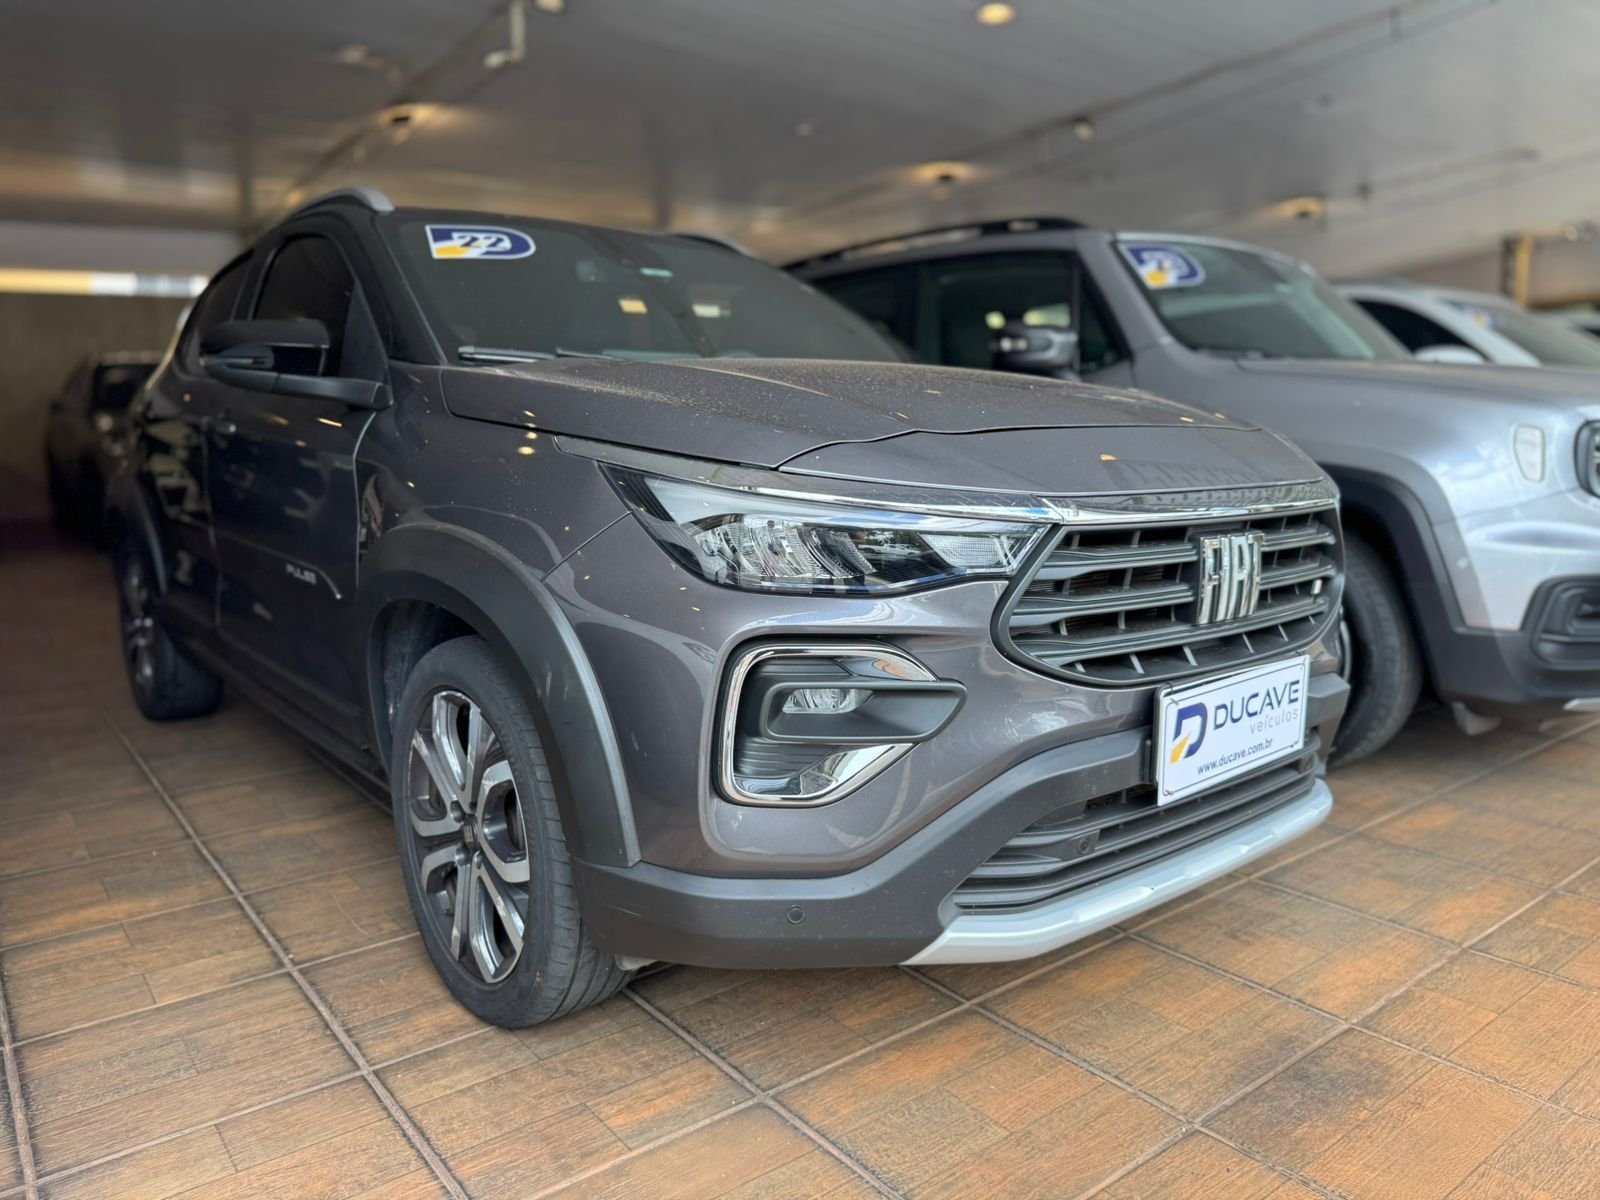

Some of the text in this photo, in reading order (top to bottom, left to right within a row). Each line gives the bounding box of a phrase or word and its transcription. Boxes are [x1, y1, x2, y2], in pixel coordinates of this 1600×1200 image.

[1198, 534, 1264, 625] FIAT
[1213, 679, 1300, 730] DUCAVE
[1249, 708, 1299, 734] veículos
[1197, 738, 1273, 775] www.ducave.com.br
